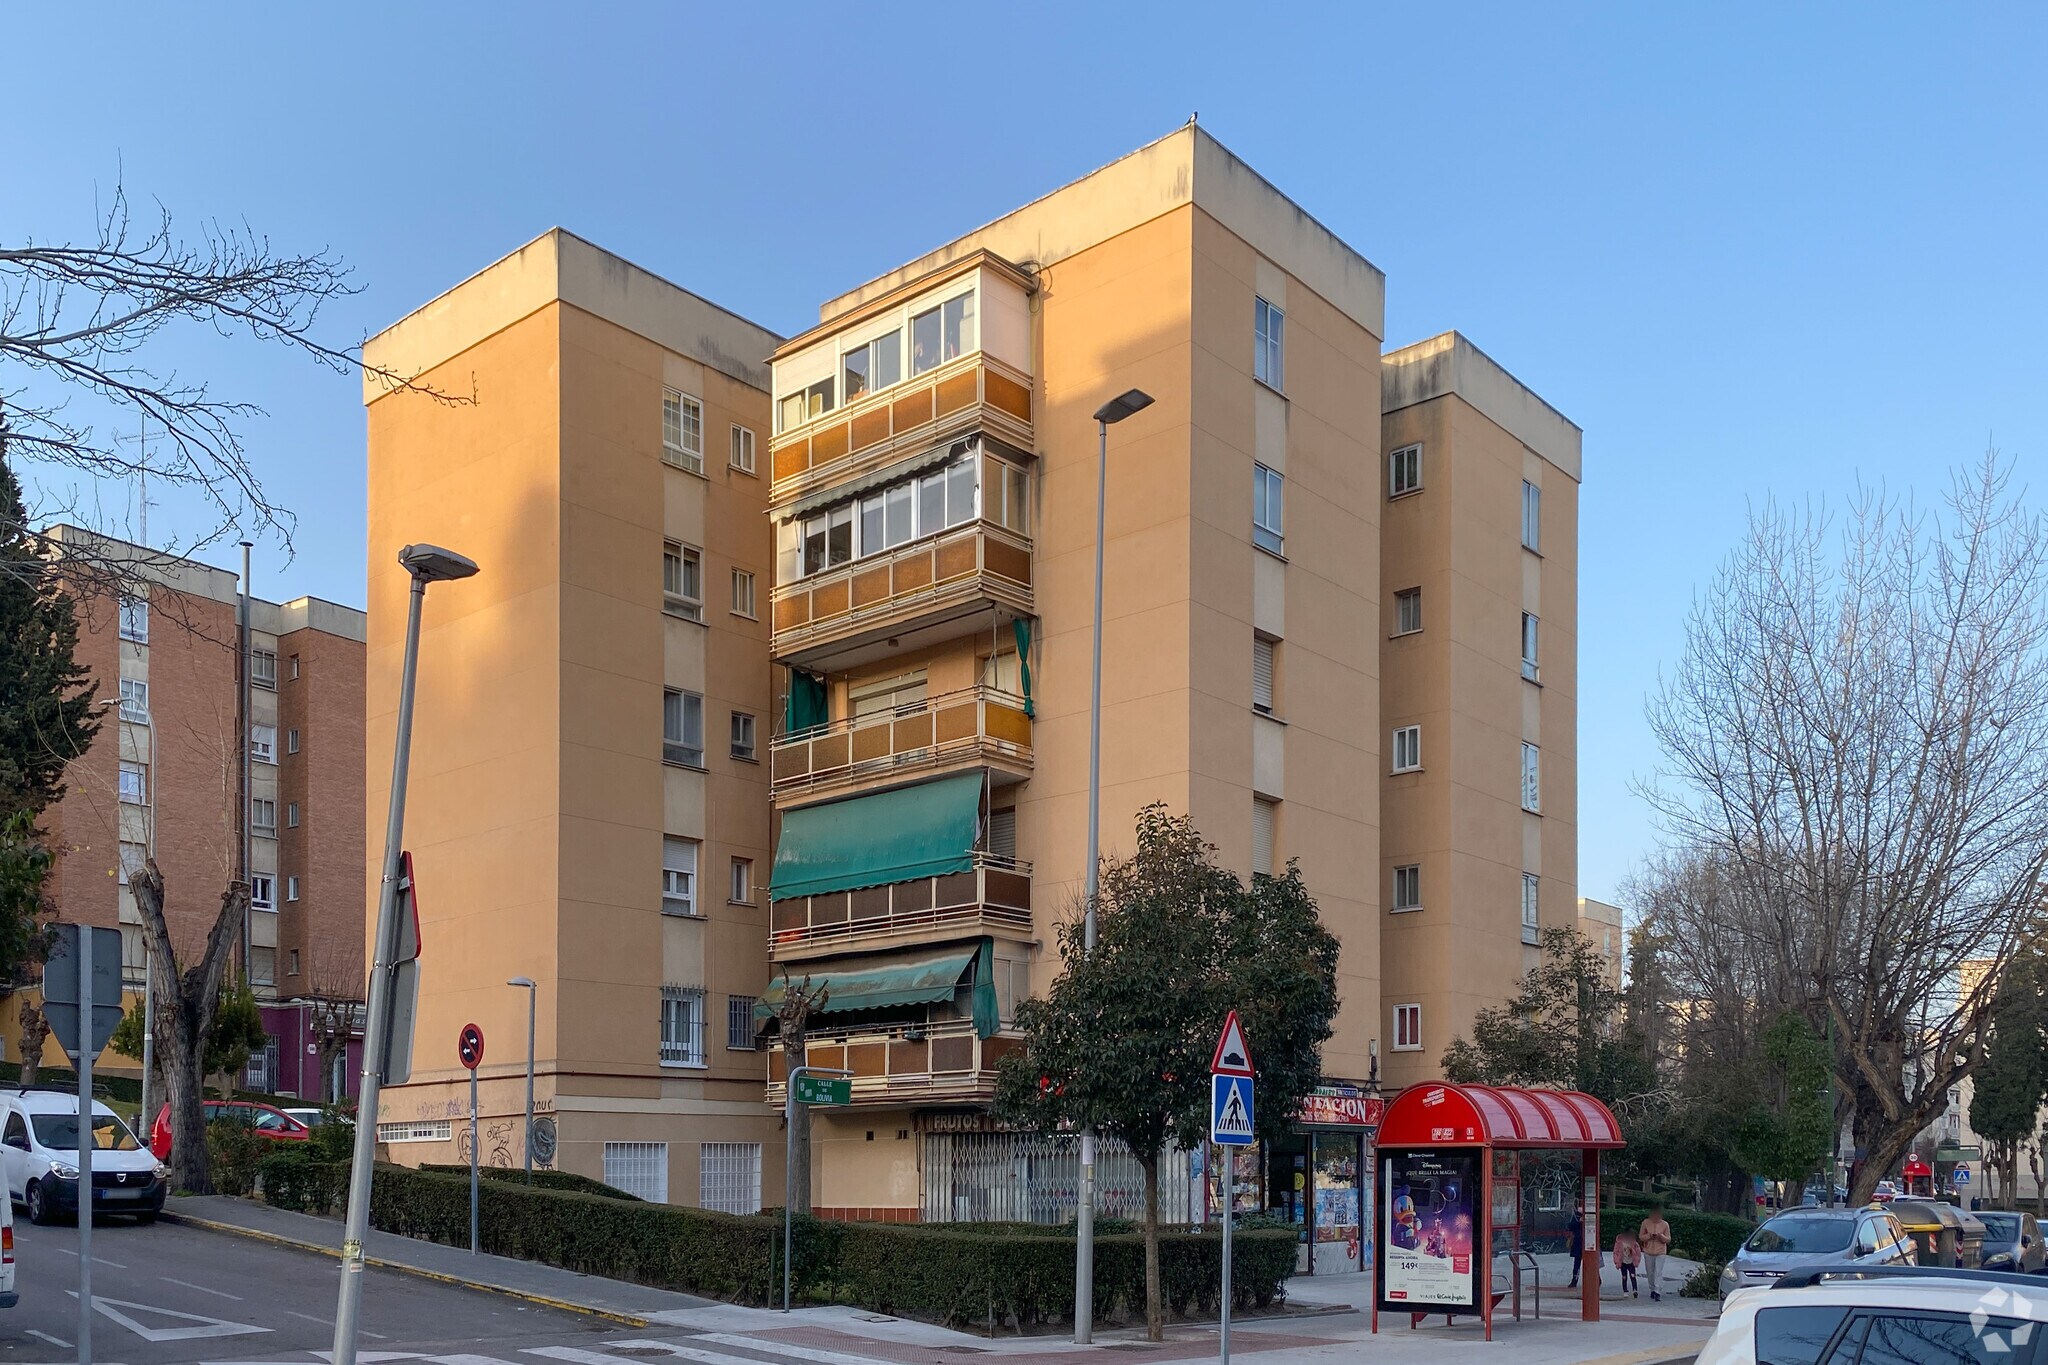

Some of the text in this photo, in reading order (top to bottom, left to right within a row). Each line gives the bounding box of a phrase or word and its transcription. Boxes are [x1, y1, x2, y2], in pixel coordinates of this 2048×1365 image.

[817, 1080, 833, 1088] CALLE
[815, 1093, 833, 1102] BOLIVIA
[1303, 1097, 1366, 1123] NTACION
[934, 1113, 979, 1129] FRUTOS
